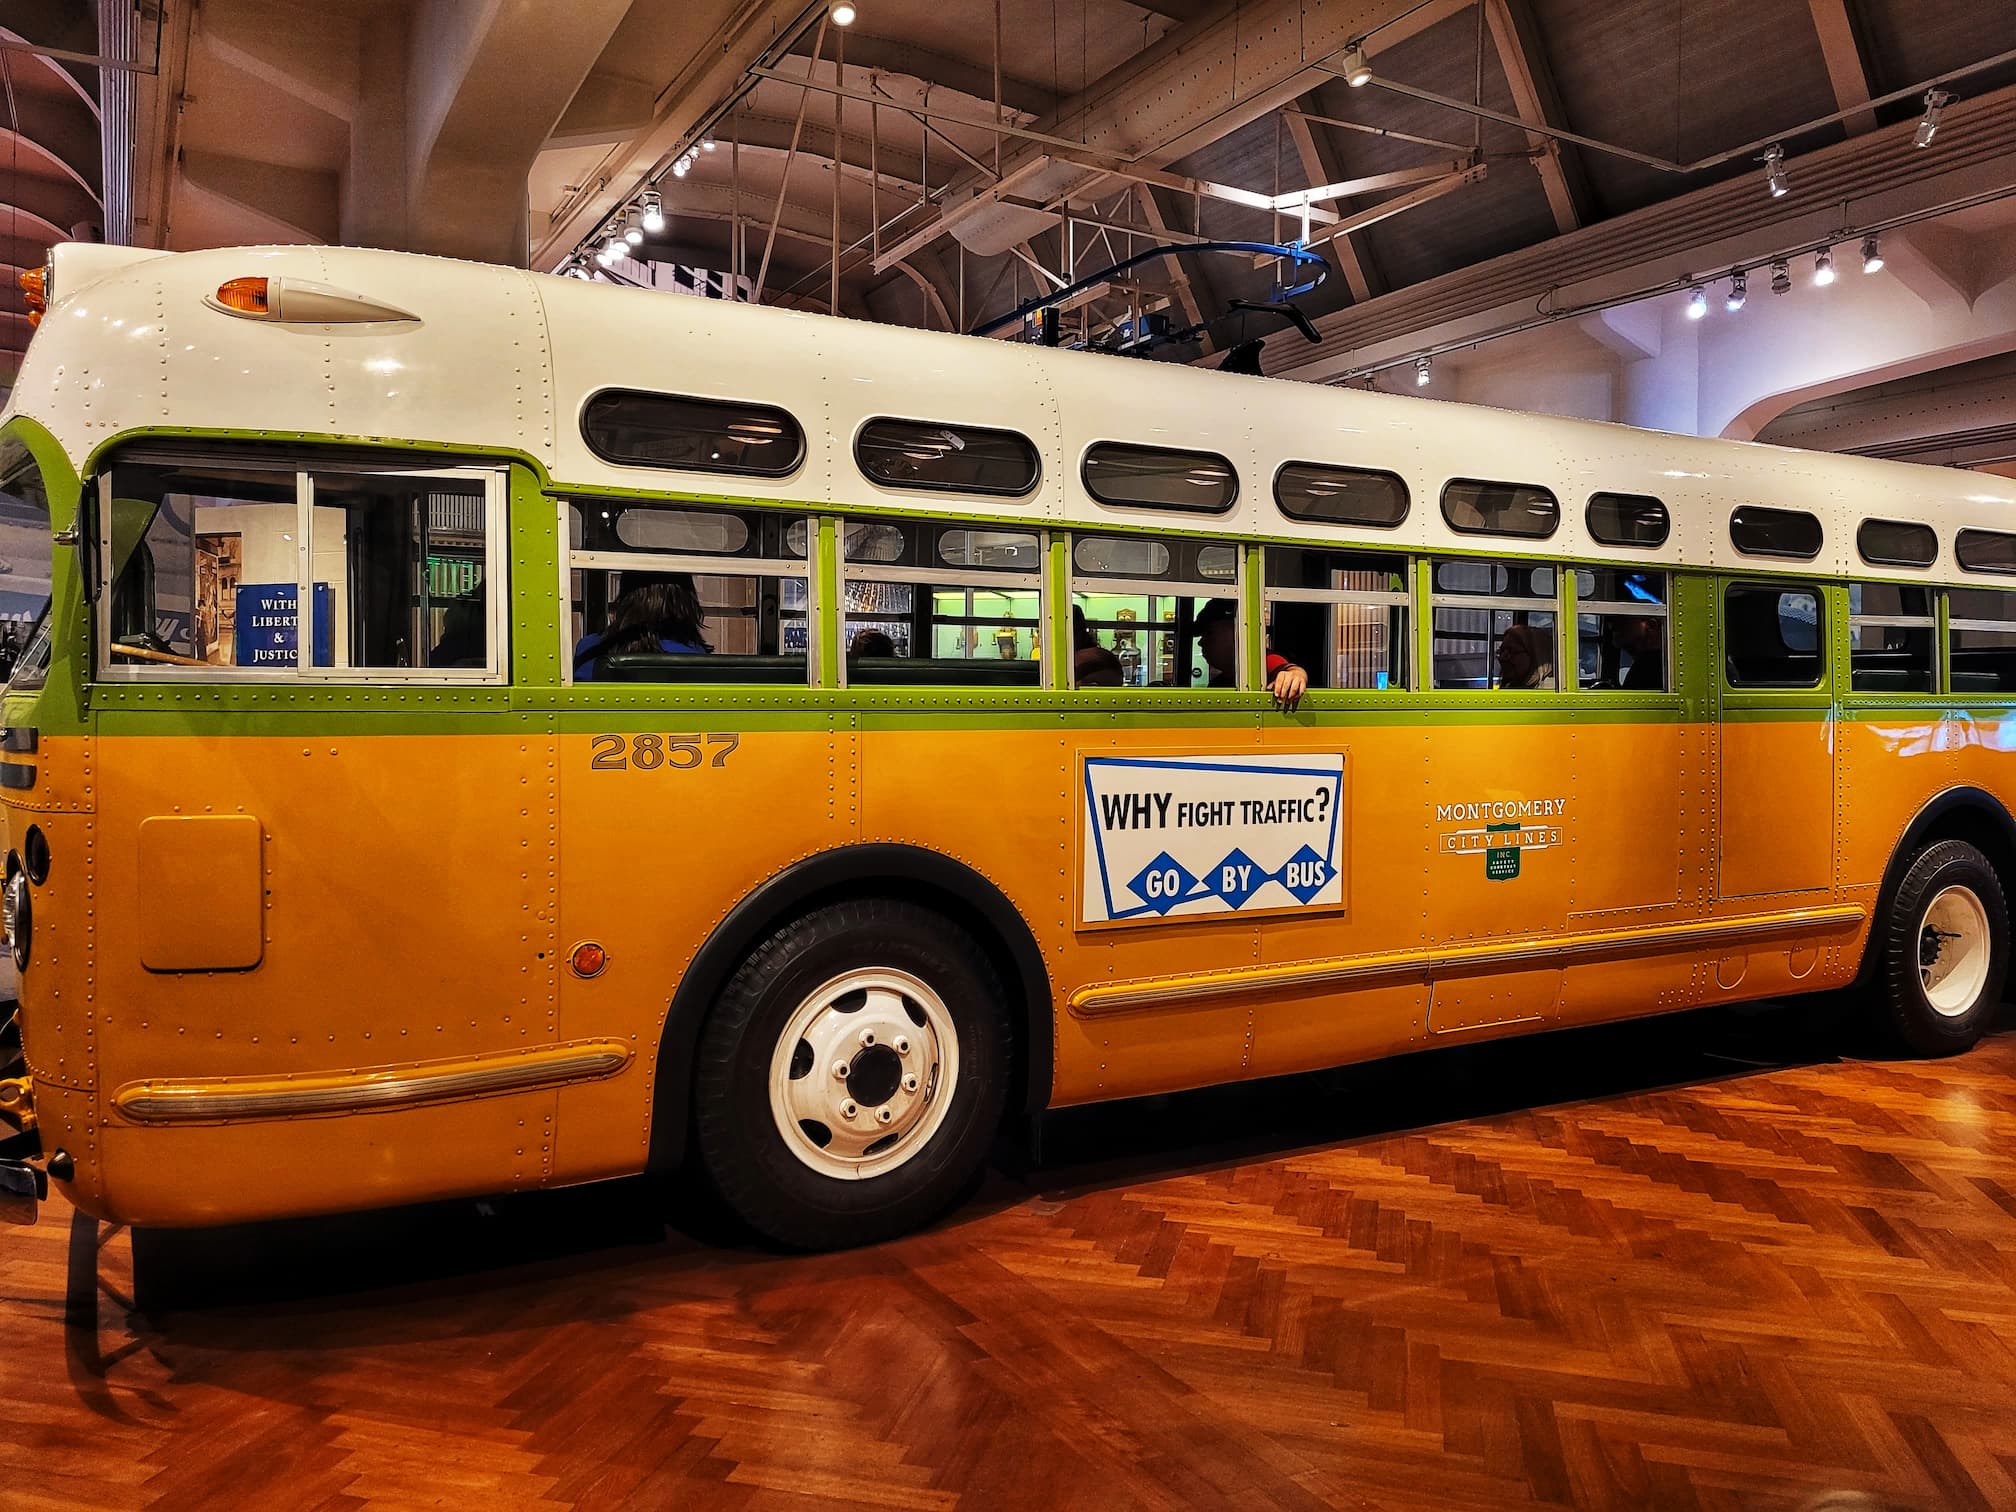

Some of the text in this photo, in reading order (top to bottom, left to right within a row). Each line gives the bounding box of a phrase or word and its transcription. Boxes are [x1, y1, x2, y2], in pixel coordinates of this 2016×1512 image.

[261, 599, 297, 610] WITH
[252, 616, 298, 627] LIBERT
[274, 632, 285, 643] &
[253, 649, 298, 662] JUSTIC
[591, 733, 739, 770] 2857
[1101, 787, 1330, 830] WHY FIGHT TRAFFIC?
[1436, 799, 1566, 821] MONTGOMERY
[1447, 831, 1557, 849] CITY LINES
[1145, 861, 1325, 897] GO BY BUS
